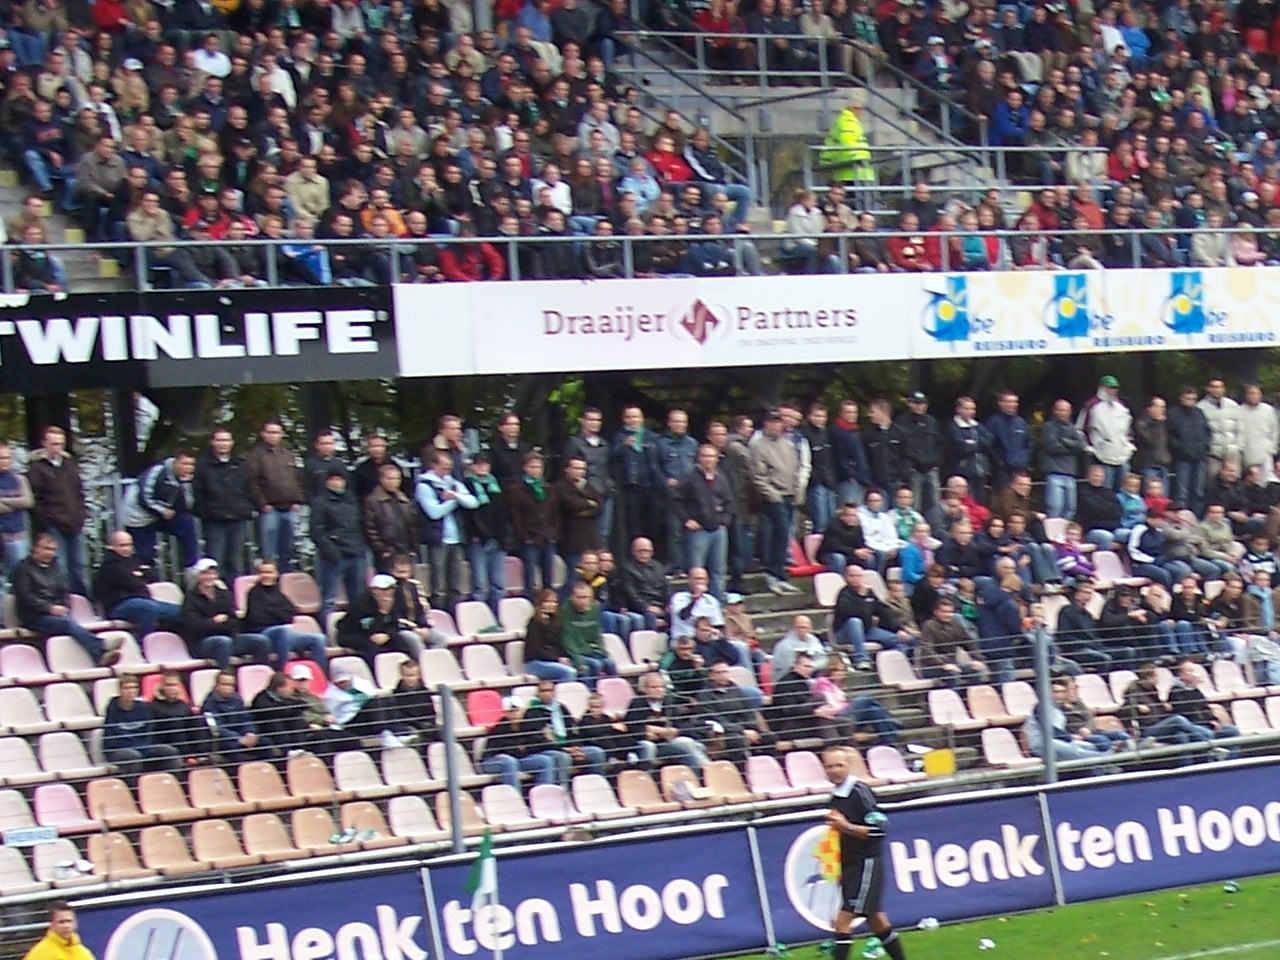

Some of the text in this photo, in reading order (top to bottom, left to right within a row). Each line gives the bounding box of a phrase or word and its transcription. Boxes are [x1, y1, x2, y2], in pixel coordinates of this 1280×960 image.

[542, 306, 857, 341] Draaijer Partners
[889, 824, 1046, 893] Henk
[1056, 818, 1154, 872] ten
[441, 897, 562, 955] ten
[568, 873, 729, 937] Hoor
